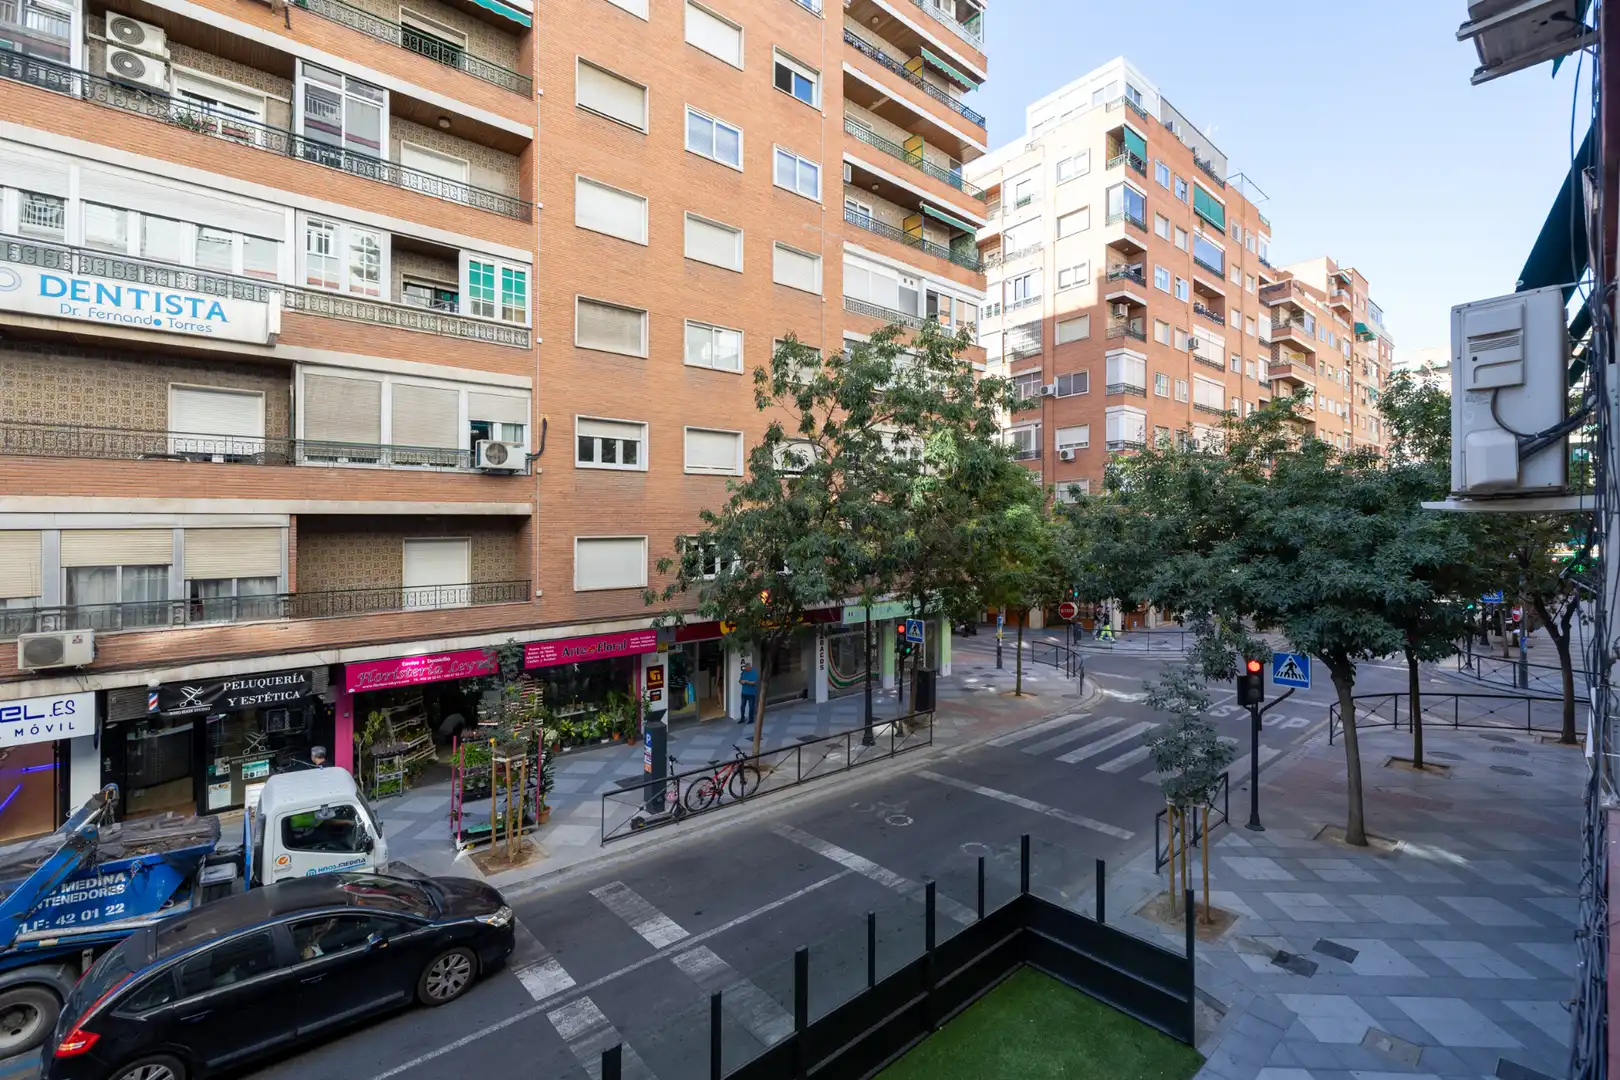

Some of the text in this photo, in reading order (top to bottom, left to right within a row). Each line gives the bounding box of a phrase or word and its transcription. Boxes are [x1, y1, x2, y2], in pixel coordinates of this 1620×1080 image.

[38, 274, 230, 323] DENTISTA
[60, 303, 81, 317] Dr.
[167, 317, 213, 333] Torres
[562, 646, 587, 657] Arte
[597, 639, 627, 653] Floral
[223, 672, 305, 691] PELUQUERÍA
[228, 690, 300, 706] Y ESTÉTICA
[14, 721, 75, 737] MÓVIL
[61, 872, 126, 894] MEDINA
[56, 913, 76, 926] 42
[81, 908, 99, 921] 01
[105, 903, 125, 916] 22
